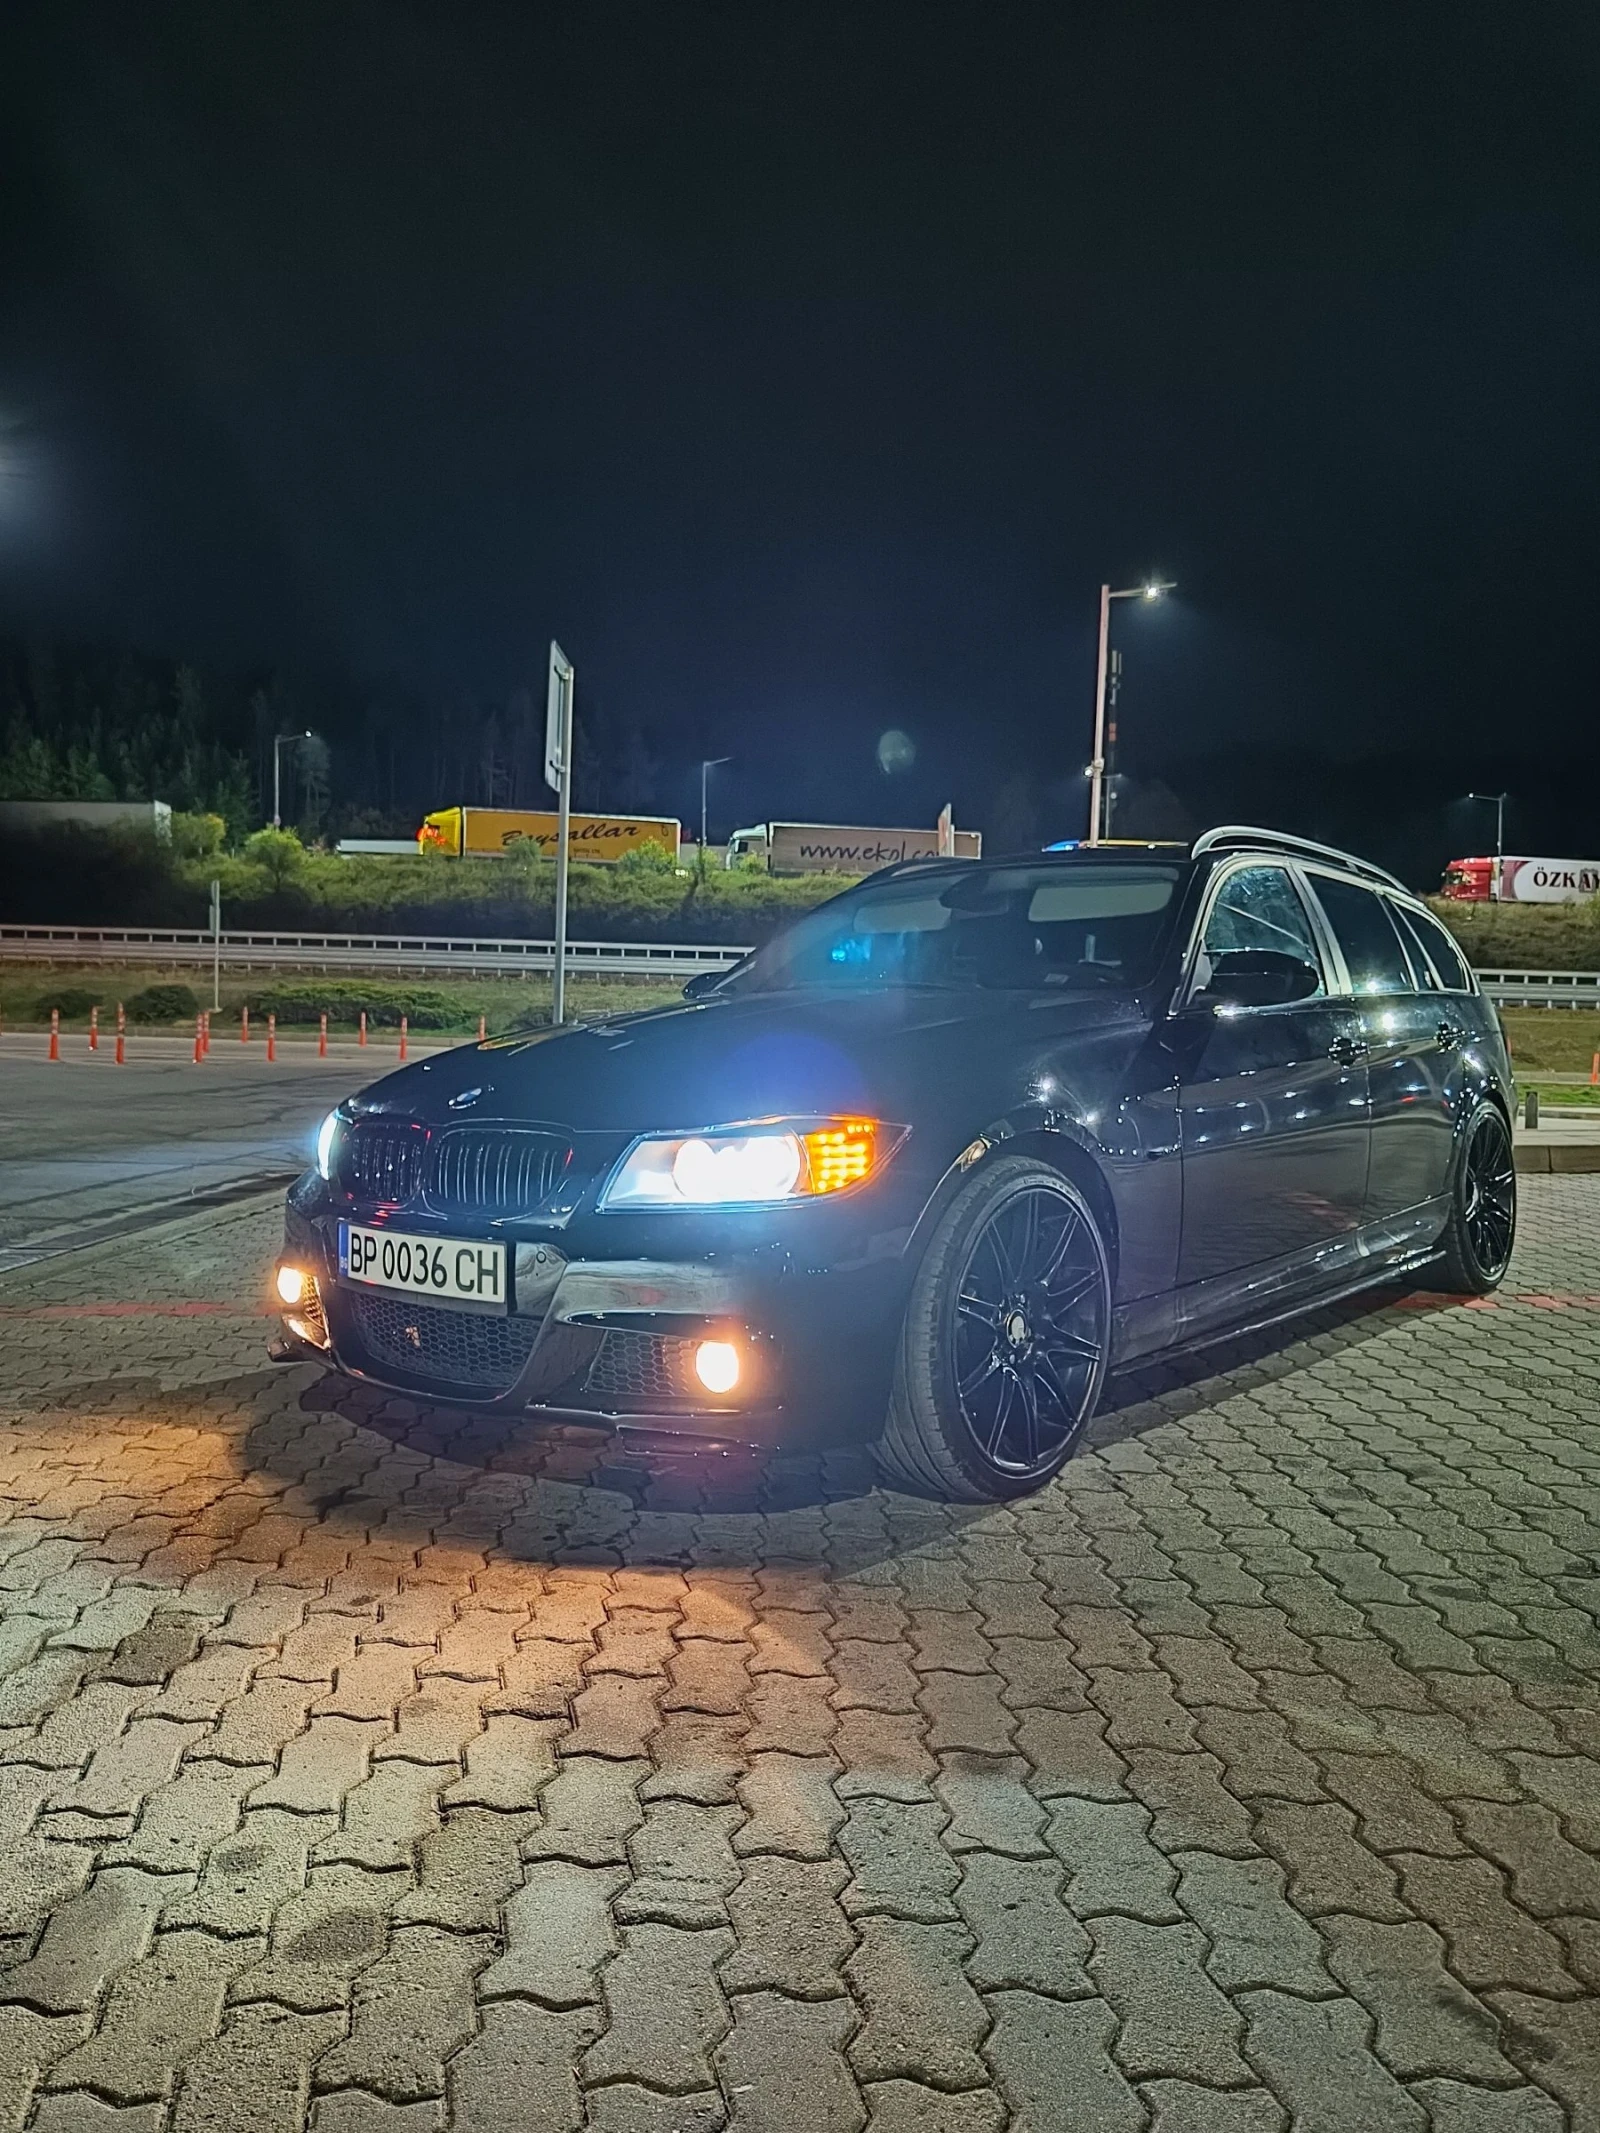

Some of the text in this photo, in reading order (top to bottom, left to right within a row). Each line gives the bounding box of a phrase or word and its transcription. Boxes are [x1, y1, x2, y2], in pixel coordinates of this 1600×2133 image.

[800, 840, 940, 863] www.ekolco
[351, 1233, 498, 1295] BP 0036 CH
